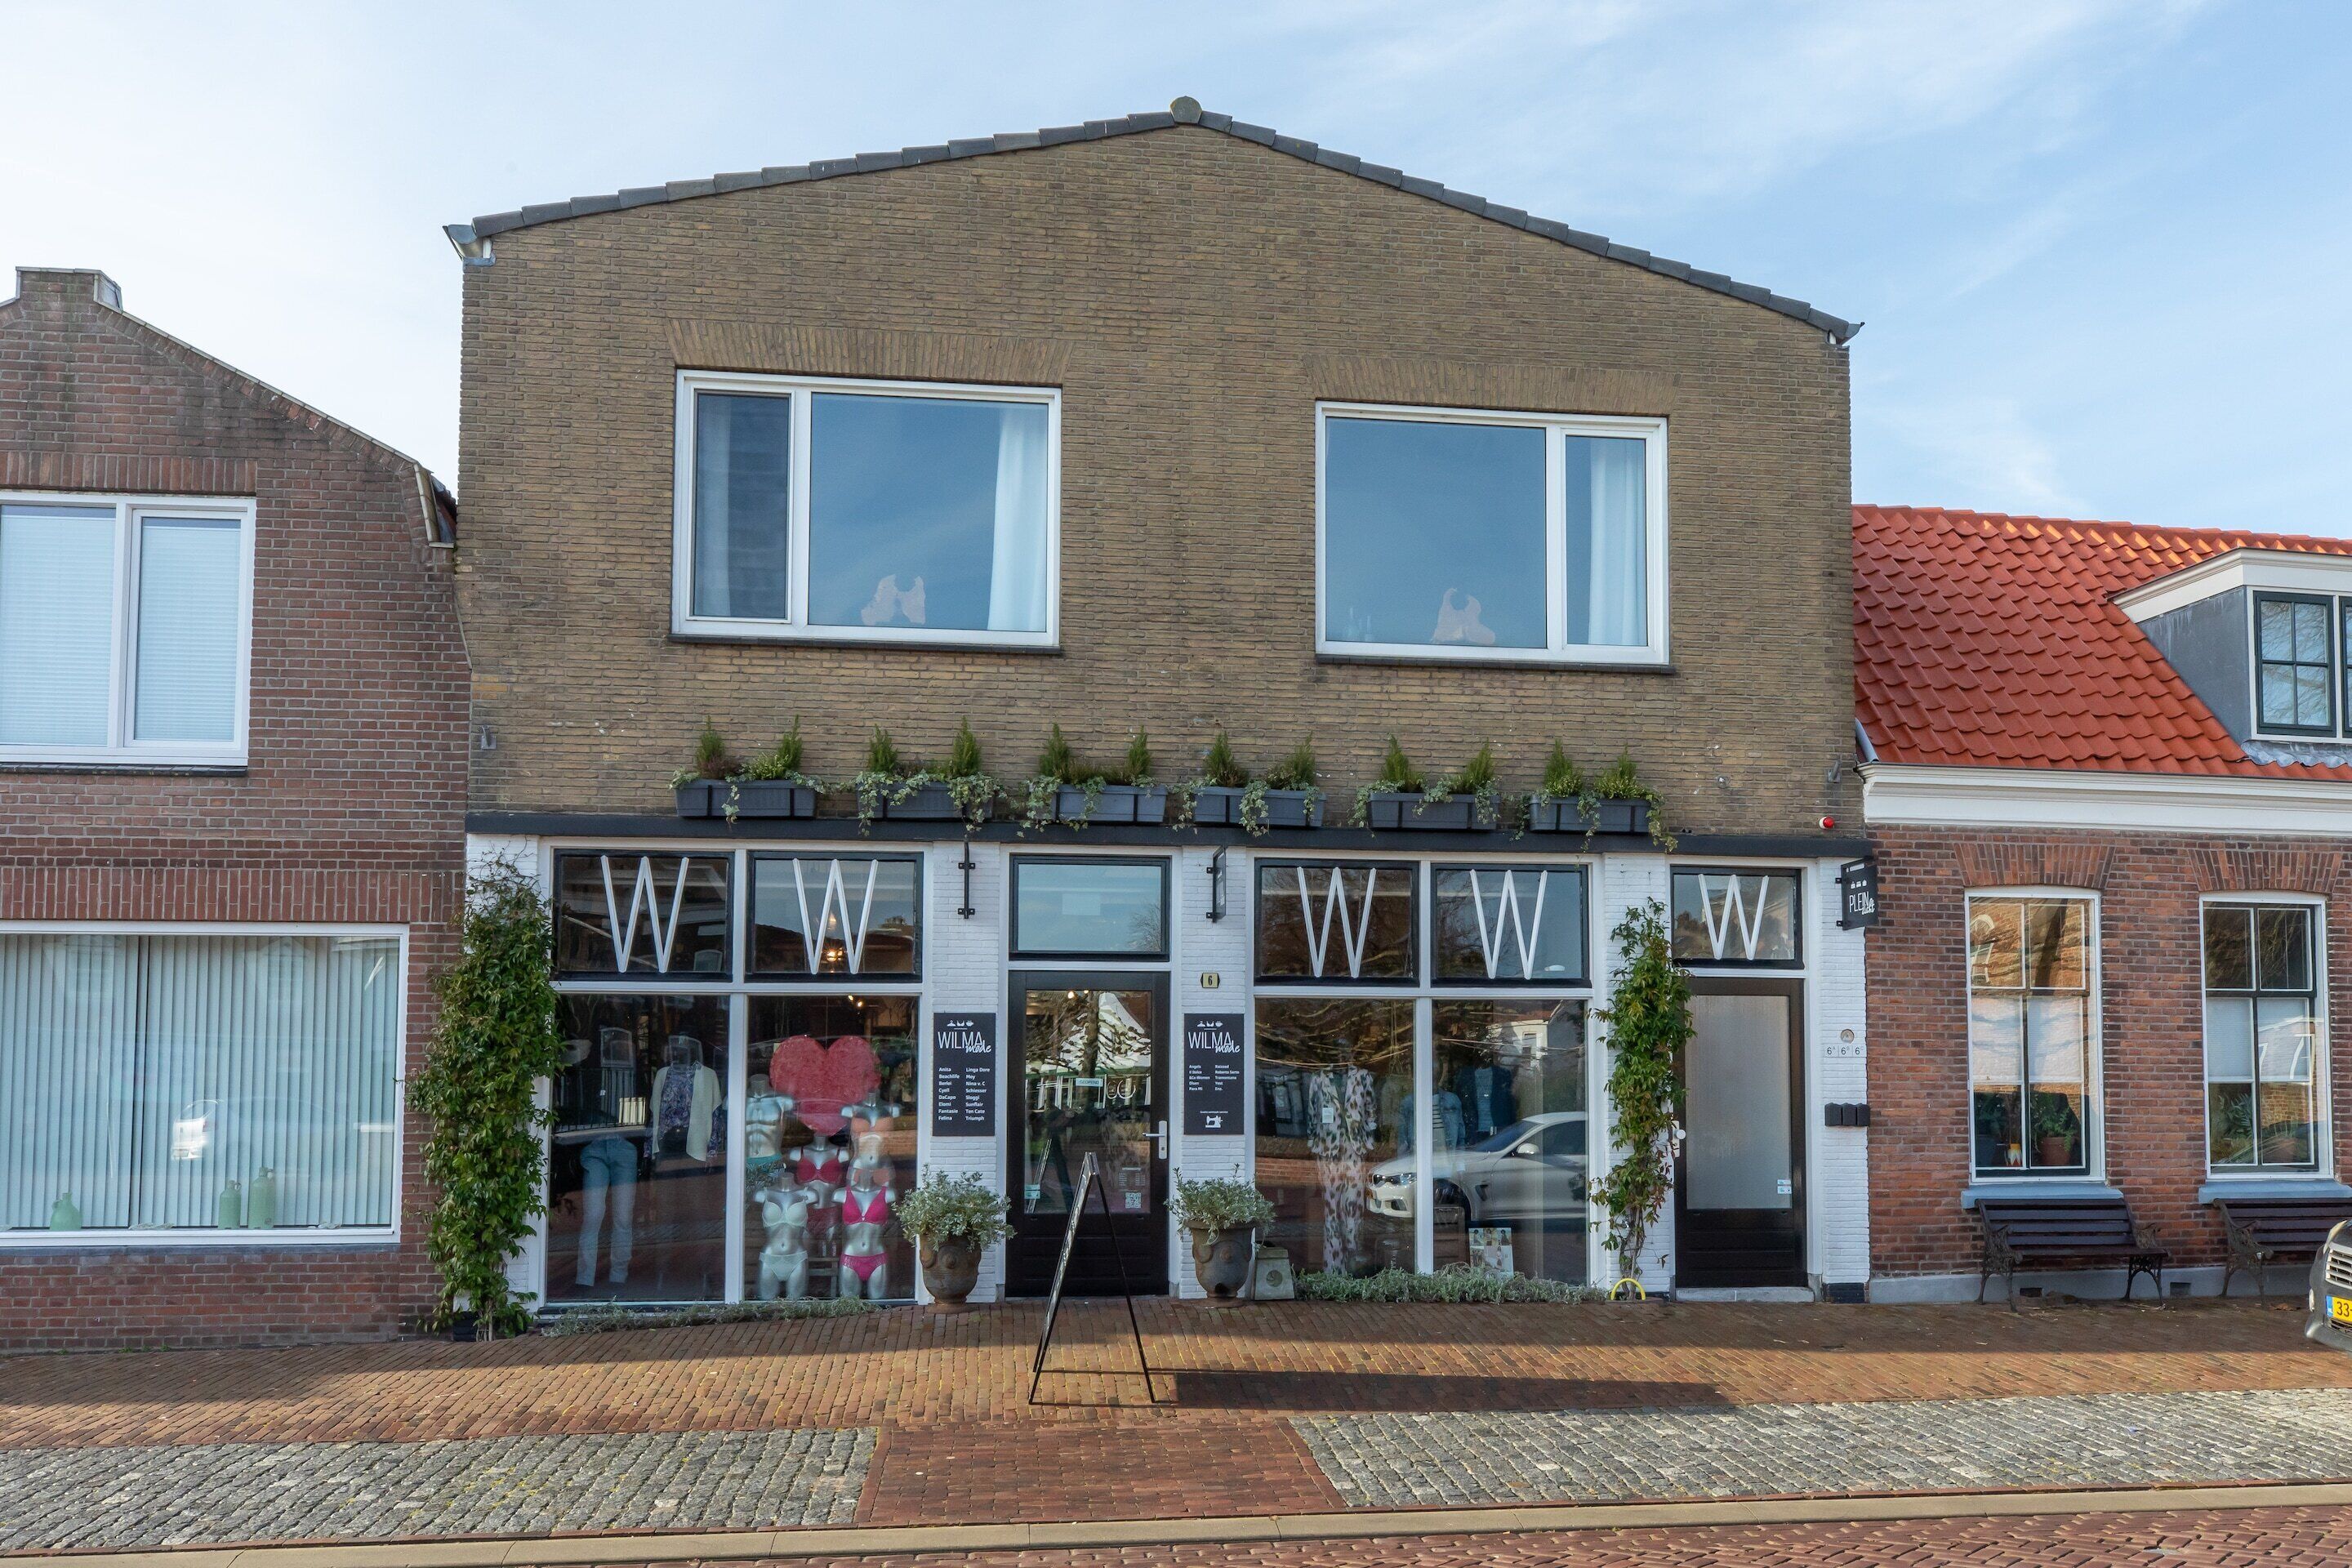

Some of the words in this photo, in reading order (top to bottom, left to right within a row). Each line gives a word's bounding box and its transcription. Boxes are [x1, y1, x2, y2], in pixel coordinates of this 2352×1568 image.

[1849, 891, 1869, 913] PLEIN
[600, 855, 688, 973] W
[793, 858, 878, 974] W
[1297, 866, 1376, 978] W
[1470, 869, 1547, 979] W
[1698, 873, 1768, 960] W
[1208, 975, 1213, 986] 6
[938, 1031, 983, 1049] WILMA
[965, 1040, 991, 1054] mode
[1188, 1031, 1232, 1049] WILMA
[1214, 1040, 1241, 1054] mode
